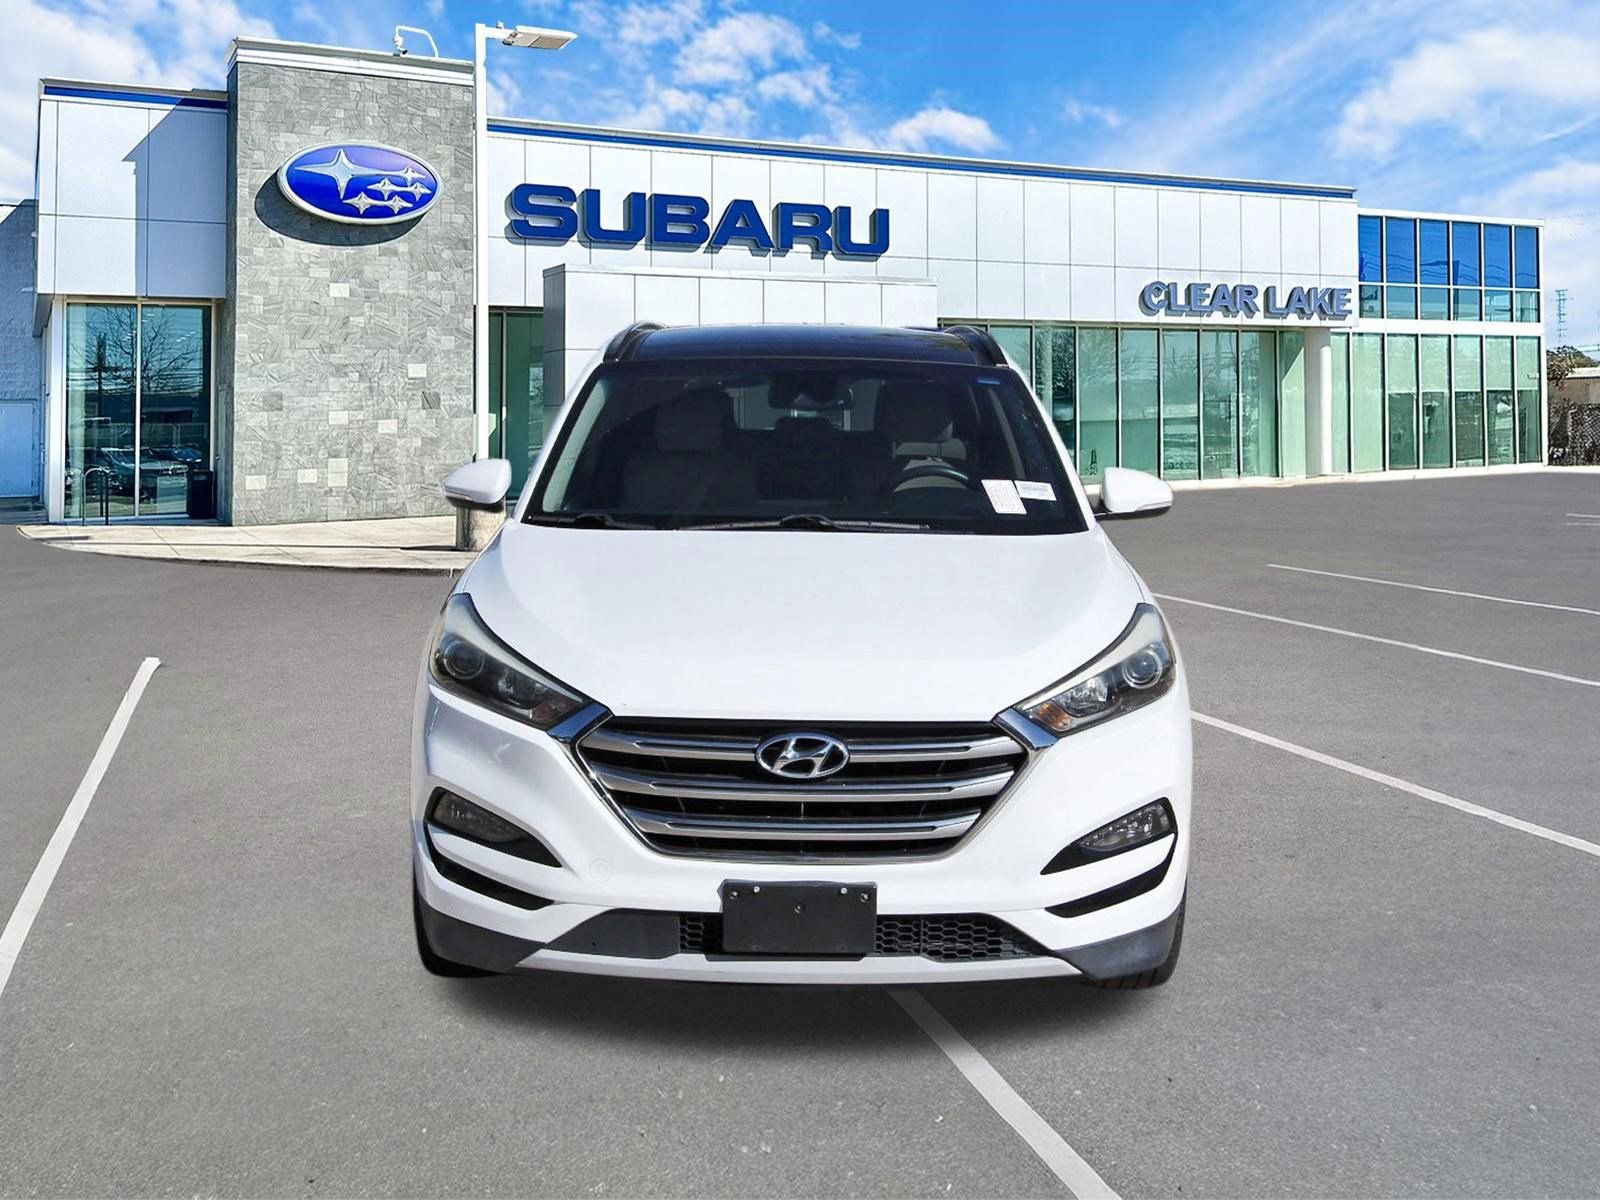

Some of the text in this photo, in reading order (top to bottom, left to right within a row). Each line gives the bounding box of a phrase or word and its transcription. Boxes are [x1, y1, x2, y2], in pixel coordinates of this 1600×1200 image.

[508, 183, 890, 257] SUBARU
[1142, 281, 1353, 317] CLEAR LAKE
